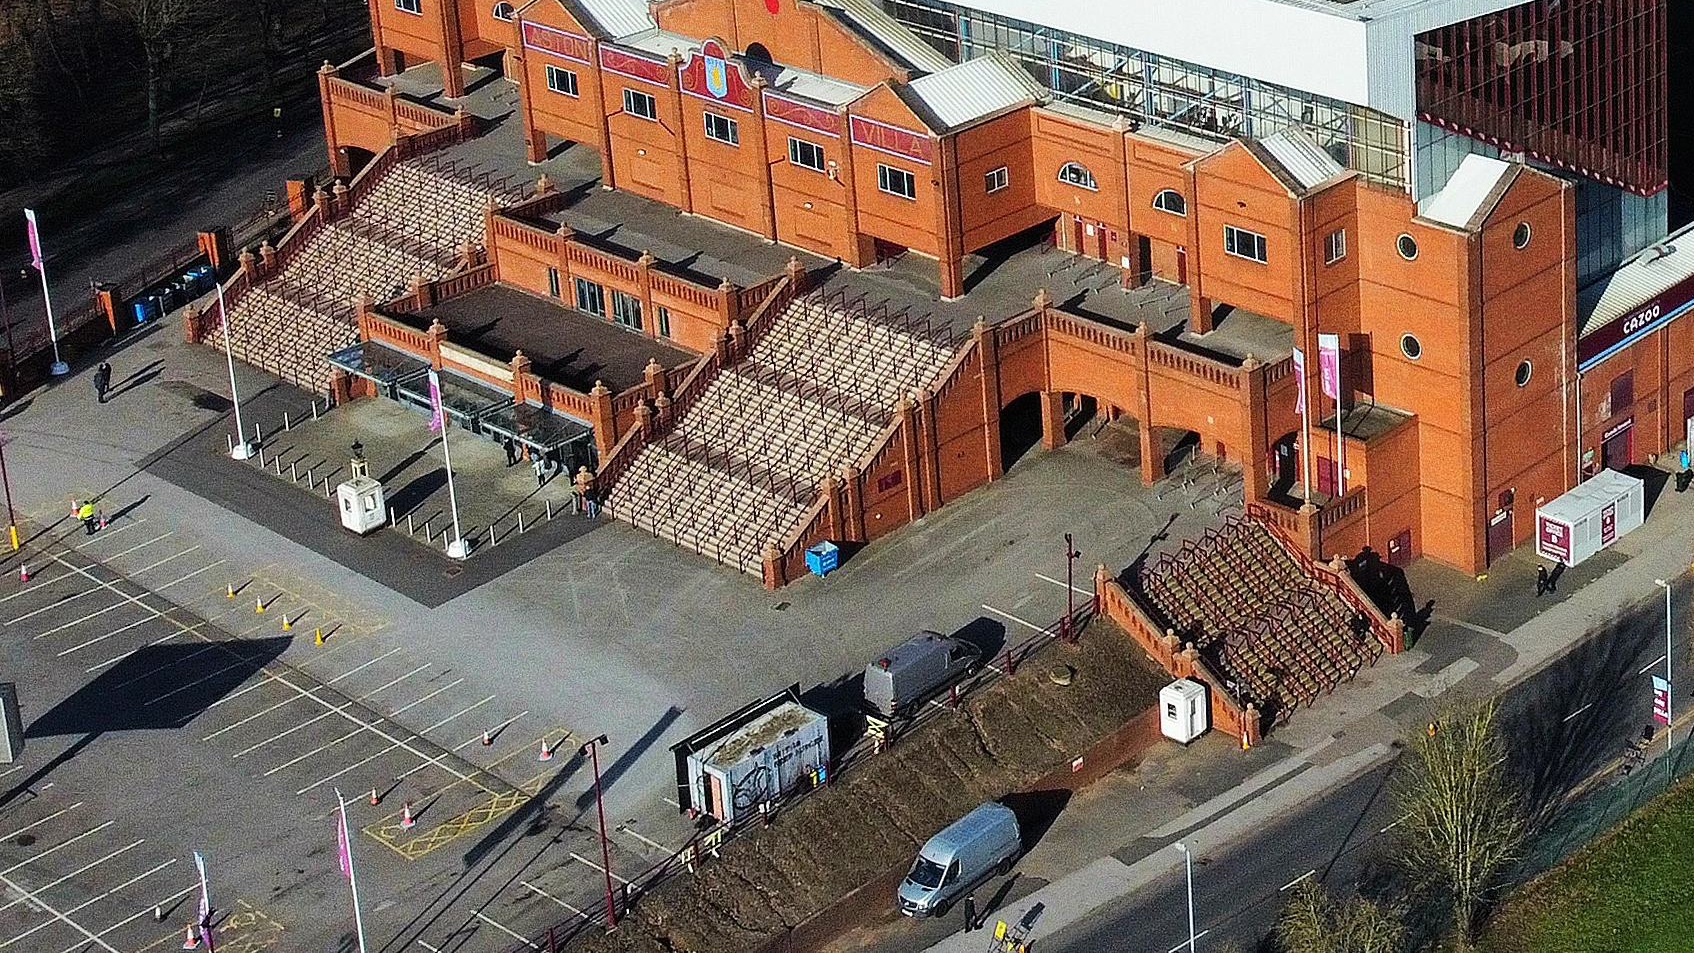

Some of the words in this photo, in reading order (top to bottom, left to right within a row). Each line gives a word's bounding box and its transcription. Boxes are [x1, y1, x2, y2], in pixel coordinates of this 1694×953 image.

[531, 29, 588, 62] ASTON
[860, 121, 921, 155] VILLA
[1623, 305, 1660, 334] CAZOO
